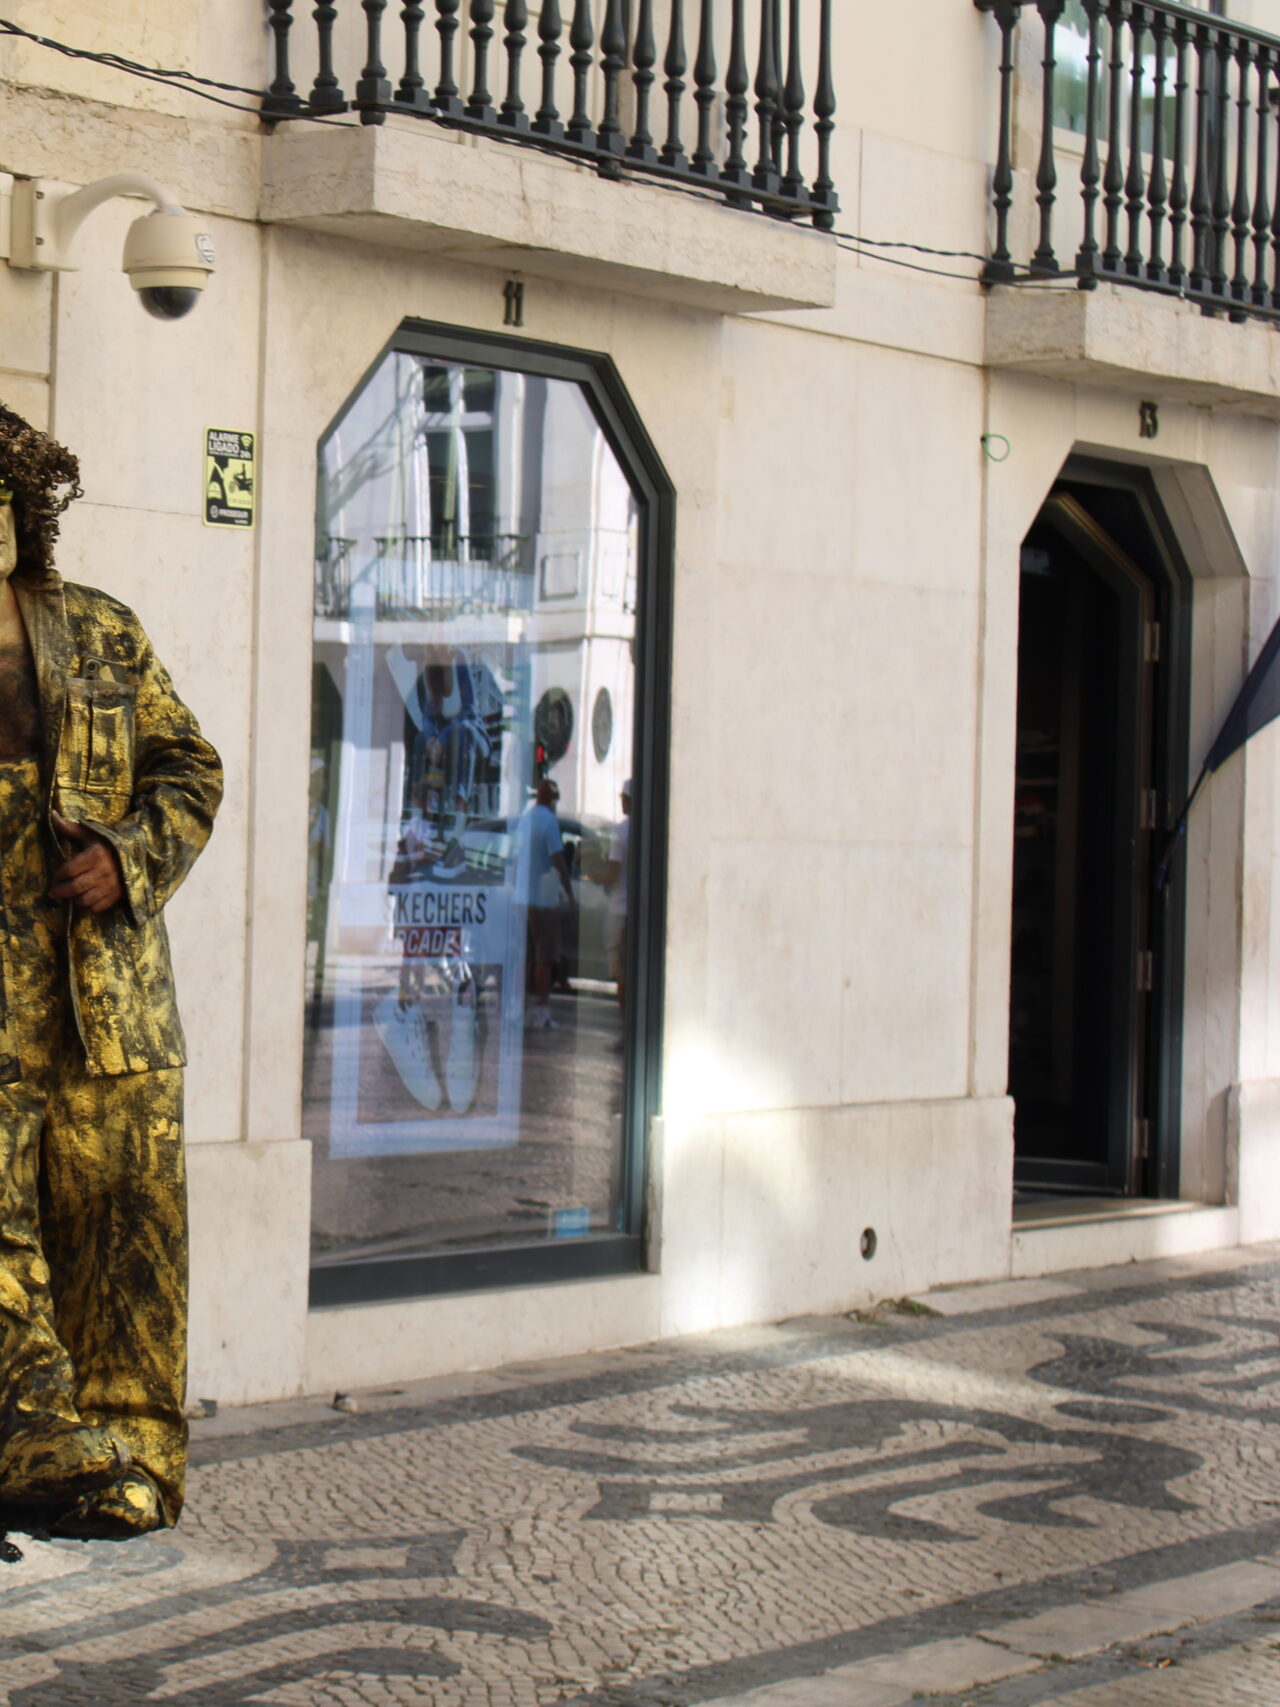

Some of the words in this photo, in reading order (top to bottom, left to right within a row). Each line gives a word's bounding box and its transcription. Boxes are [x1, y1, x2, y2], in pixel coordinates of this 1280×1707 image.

[503, 280, 524, 327] 11
[209, 431, 240, 443] ALARME
[208, 440, 240, 453] LIGADO
